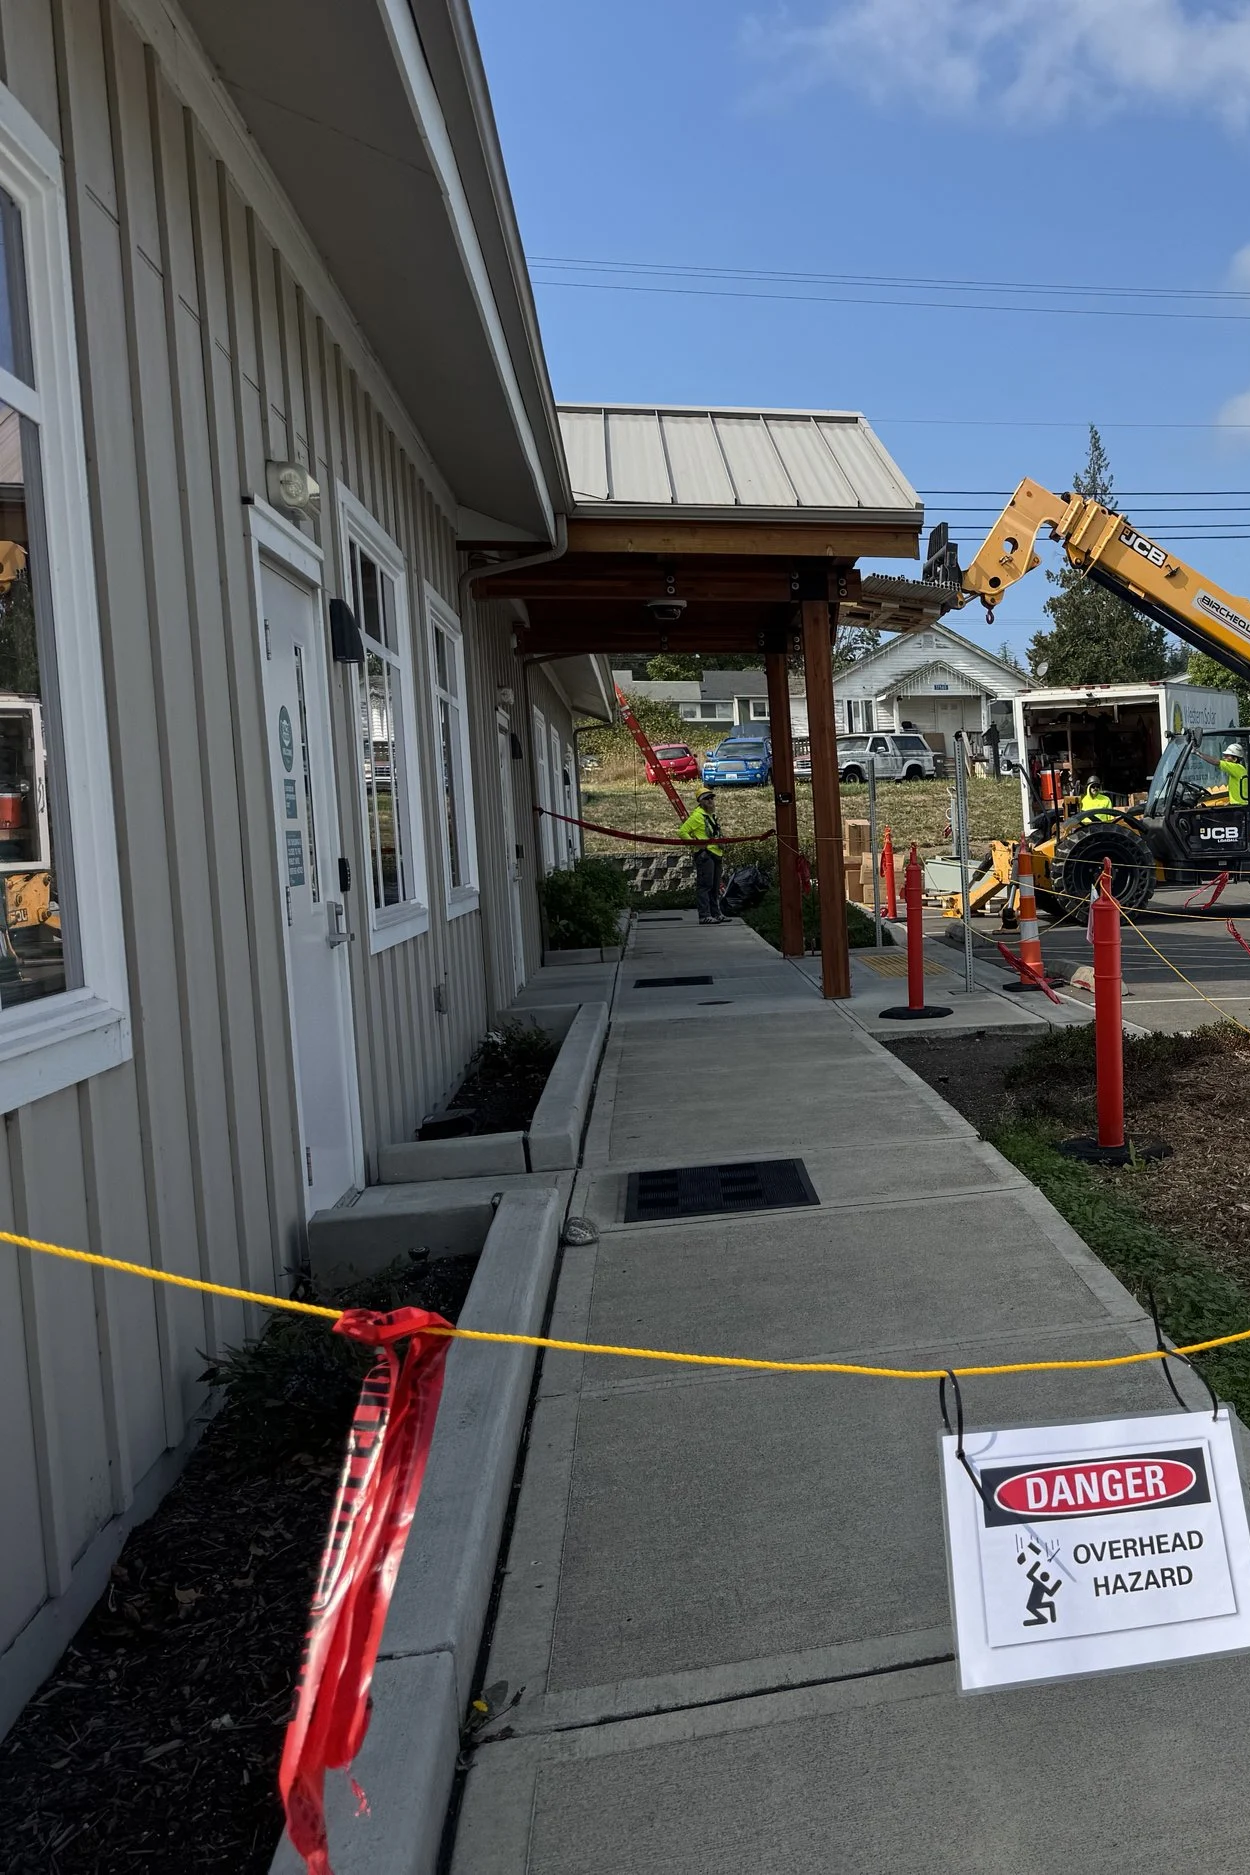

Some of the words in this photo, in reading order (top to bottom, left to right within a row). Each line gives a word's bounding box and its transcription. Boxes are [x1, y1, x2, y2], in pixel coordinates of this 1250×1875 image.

[1119, 527, 1168, 567] JCB
[1200, 826, 1239, 839] JCB
[1025, 1464, 1168, 1510] DANGER
[1072, 1530, 1205, 1565] OVERHEAD
[1093, 1565, 1194, 1597] HAZARD
